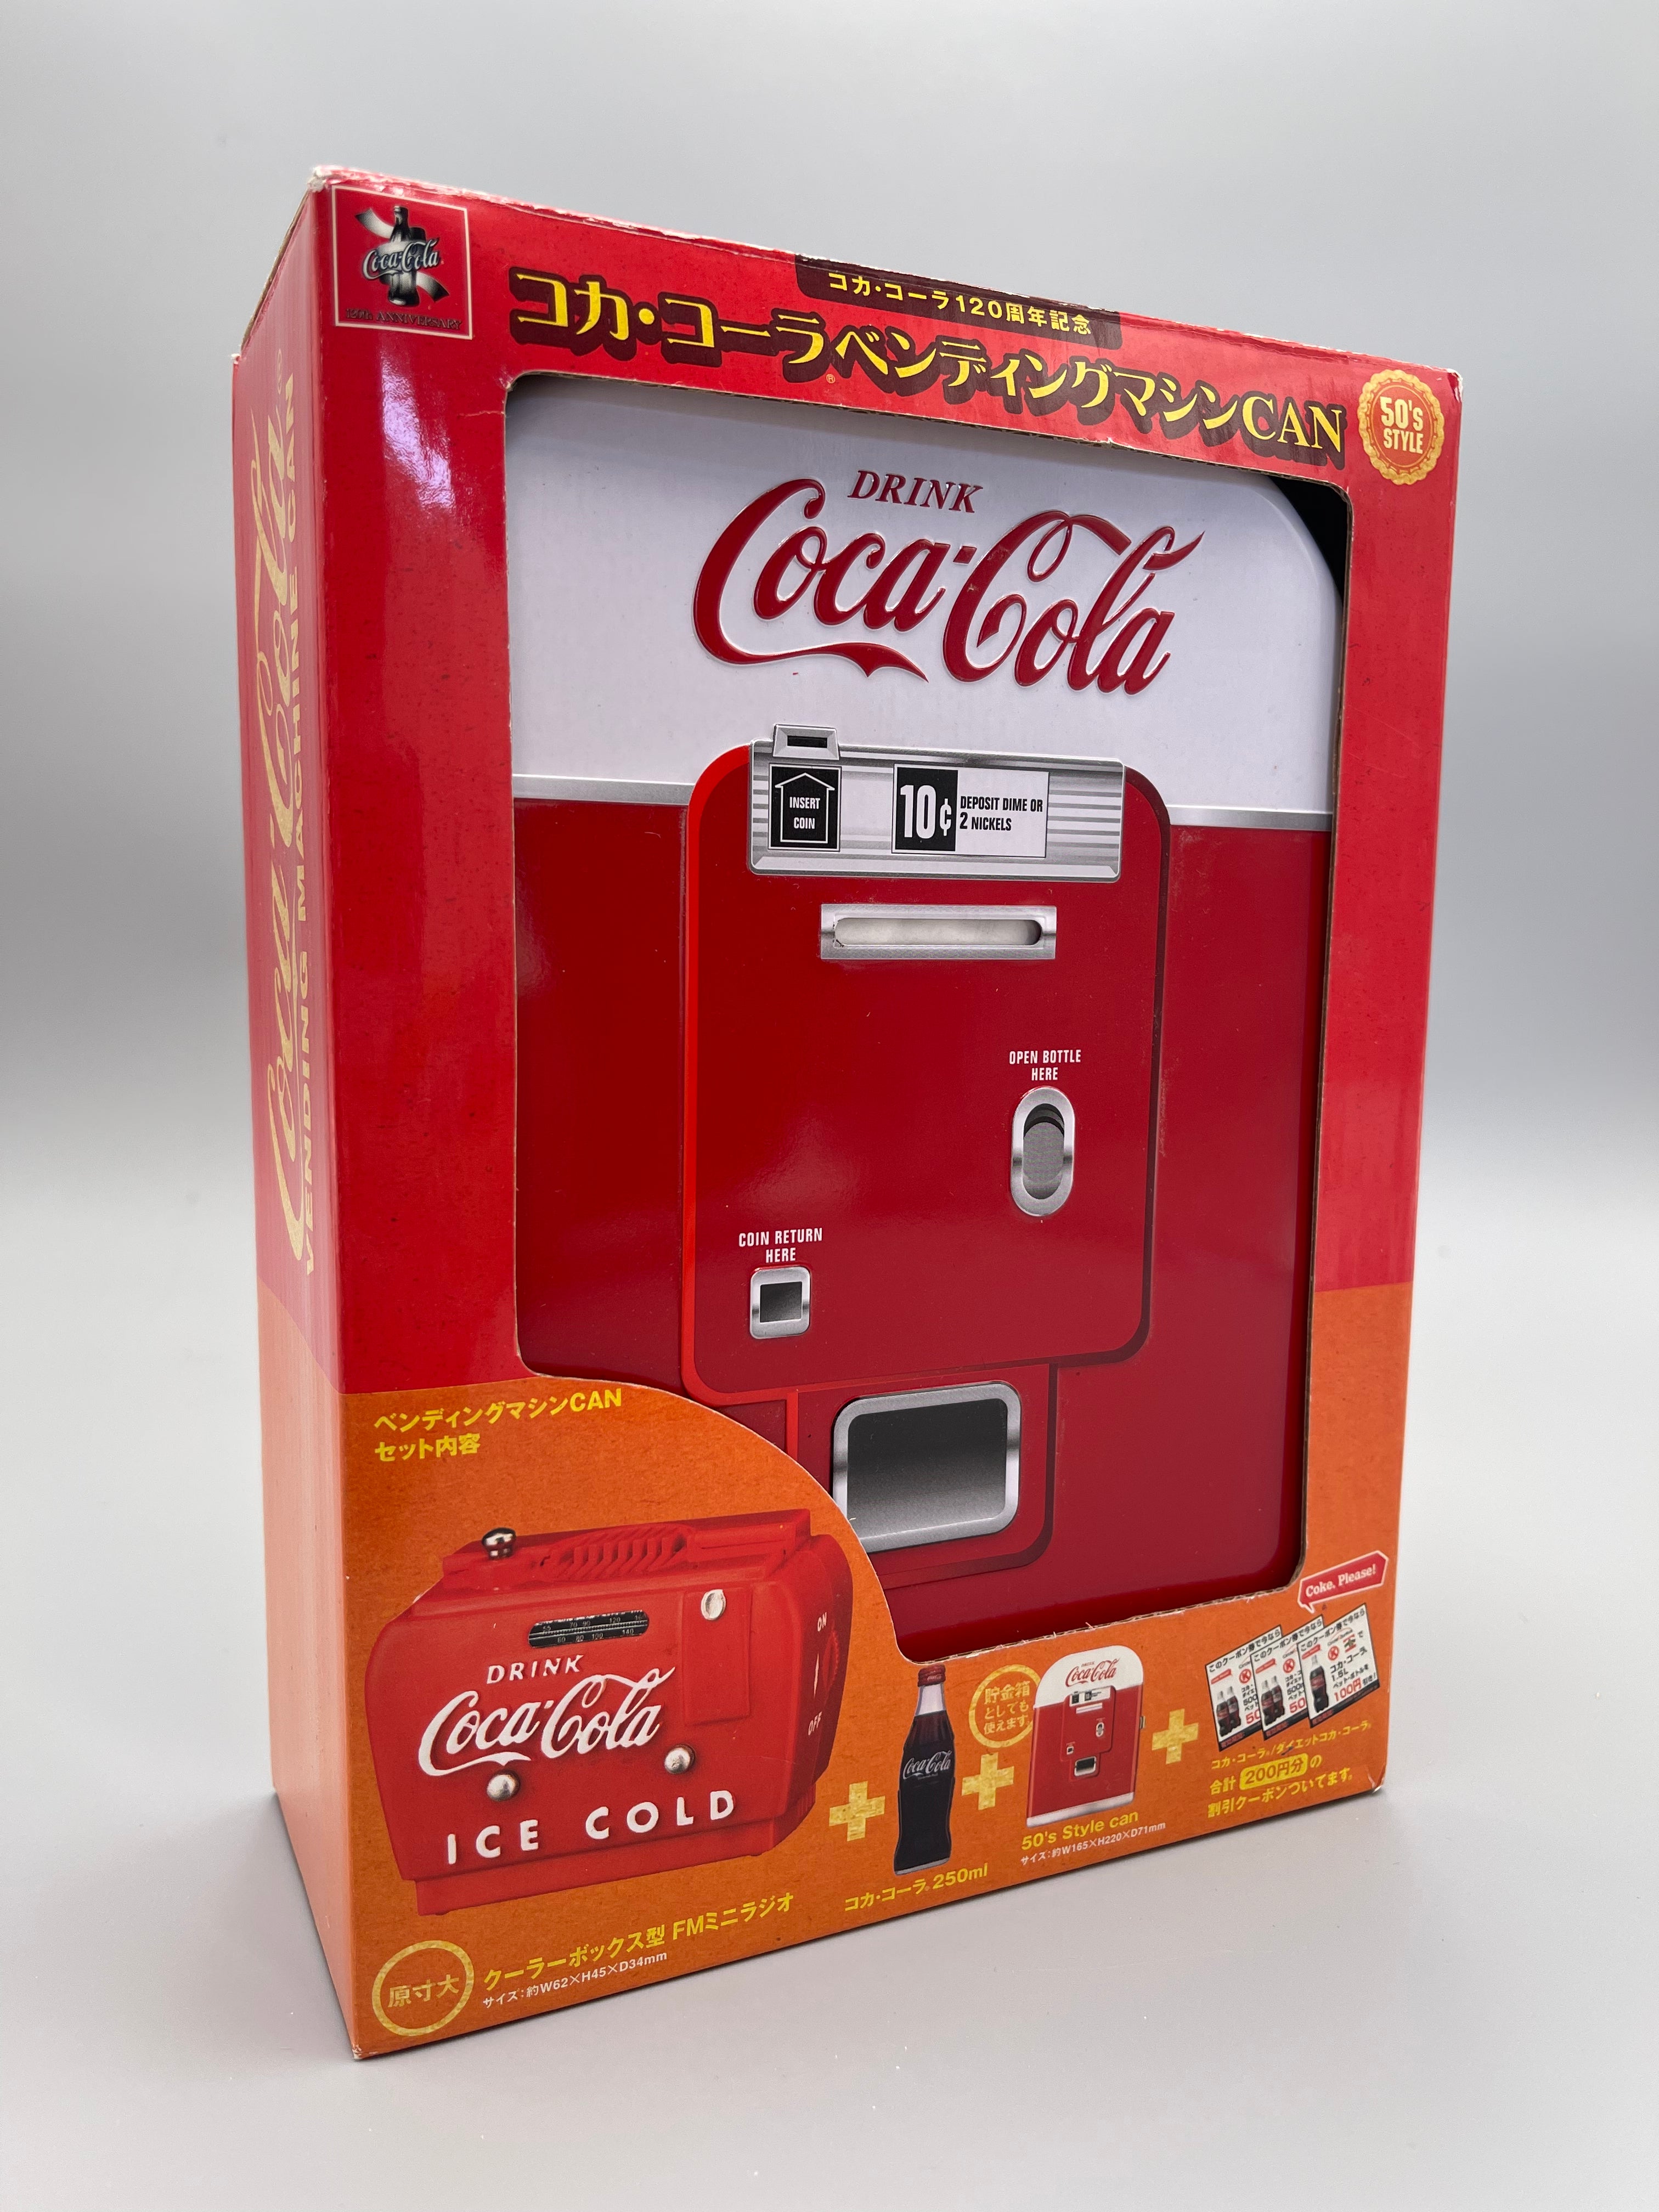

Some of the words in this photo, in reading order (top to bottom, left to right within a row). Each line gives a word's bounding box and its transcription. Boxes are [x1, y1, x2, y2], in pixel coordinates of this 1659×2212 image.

[362, 237, 440, 280] Coca-Cola
[828, 272, 1092, 335] コカ・コーラ120周年記念
[1379, 396, 1424, 428] 50's
[1383, 428, 1423, 455] STYLE
[285, 372, 297, 543] CAN
[847, 469, 984, 514] DRINK
[692, 477, 1204, 696] Coca-Cola
[289, 566, 307, 922] MACHINE
[789, 796, 821, 811] INSERT
[960, 795, 1000, 811] DEPOSIT
[1002, 797, 1028, 812] DIME
[1030, 799, 1043, 812] OR
[793, 816, 815, 830] COIN
[960, 811, 968, 830] 2
[971, 816, 1012, 832] NICKELS
[1009, 1050, 1038, 1064] OPEN
[1042, 1049, 1081, 1064] BOTTLE
[1031, 1067, 1058, 1081] HERE
[300, 951, 314, 1276] VENDING
[738, 1231, 770, 1247] COIN
[775, 1227, 822, 1245] RETURN
[766, 1247, 796, 1263] HERE
[374, 1387, 623, 1433] ベンディングマシンCAN
[374, 1432, 481, 1463] セット内容
[1338, 1563, 1376, 1587] Please!
[817, 1612, 827, 1632] ON
[486, 1655, 584, 1685] DRINK
[1065, 1657, 1120, 1688] Coca-Cola
[984, 1680, 1031, 1705] 貯金箱
[417, 1667, 676, 1777] Coca-Cola
[808, 1711, 822, 1736] OFF
[984, 1700, 1029, 1720] としても
[902, 1750, 953, 1780] Coca-Cola
[447, 1819, 539, 1865] ICE
[585, 1790, 735, 1840] COLD
[1020, 1830, 1057, 1850] 50's
[1062, 1819, 1104, 1839] Style
[1109, 1811, 1138, 1829] can
[932, 1862, 988, 1889] 250ml
[483, 1923, 665, 1991] クーラーボックス型
[672, 1892, 794, 1940] FMミニラジオ
[387, 1974, 460, 2008] 原寸大
